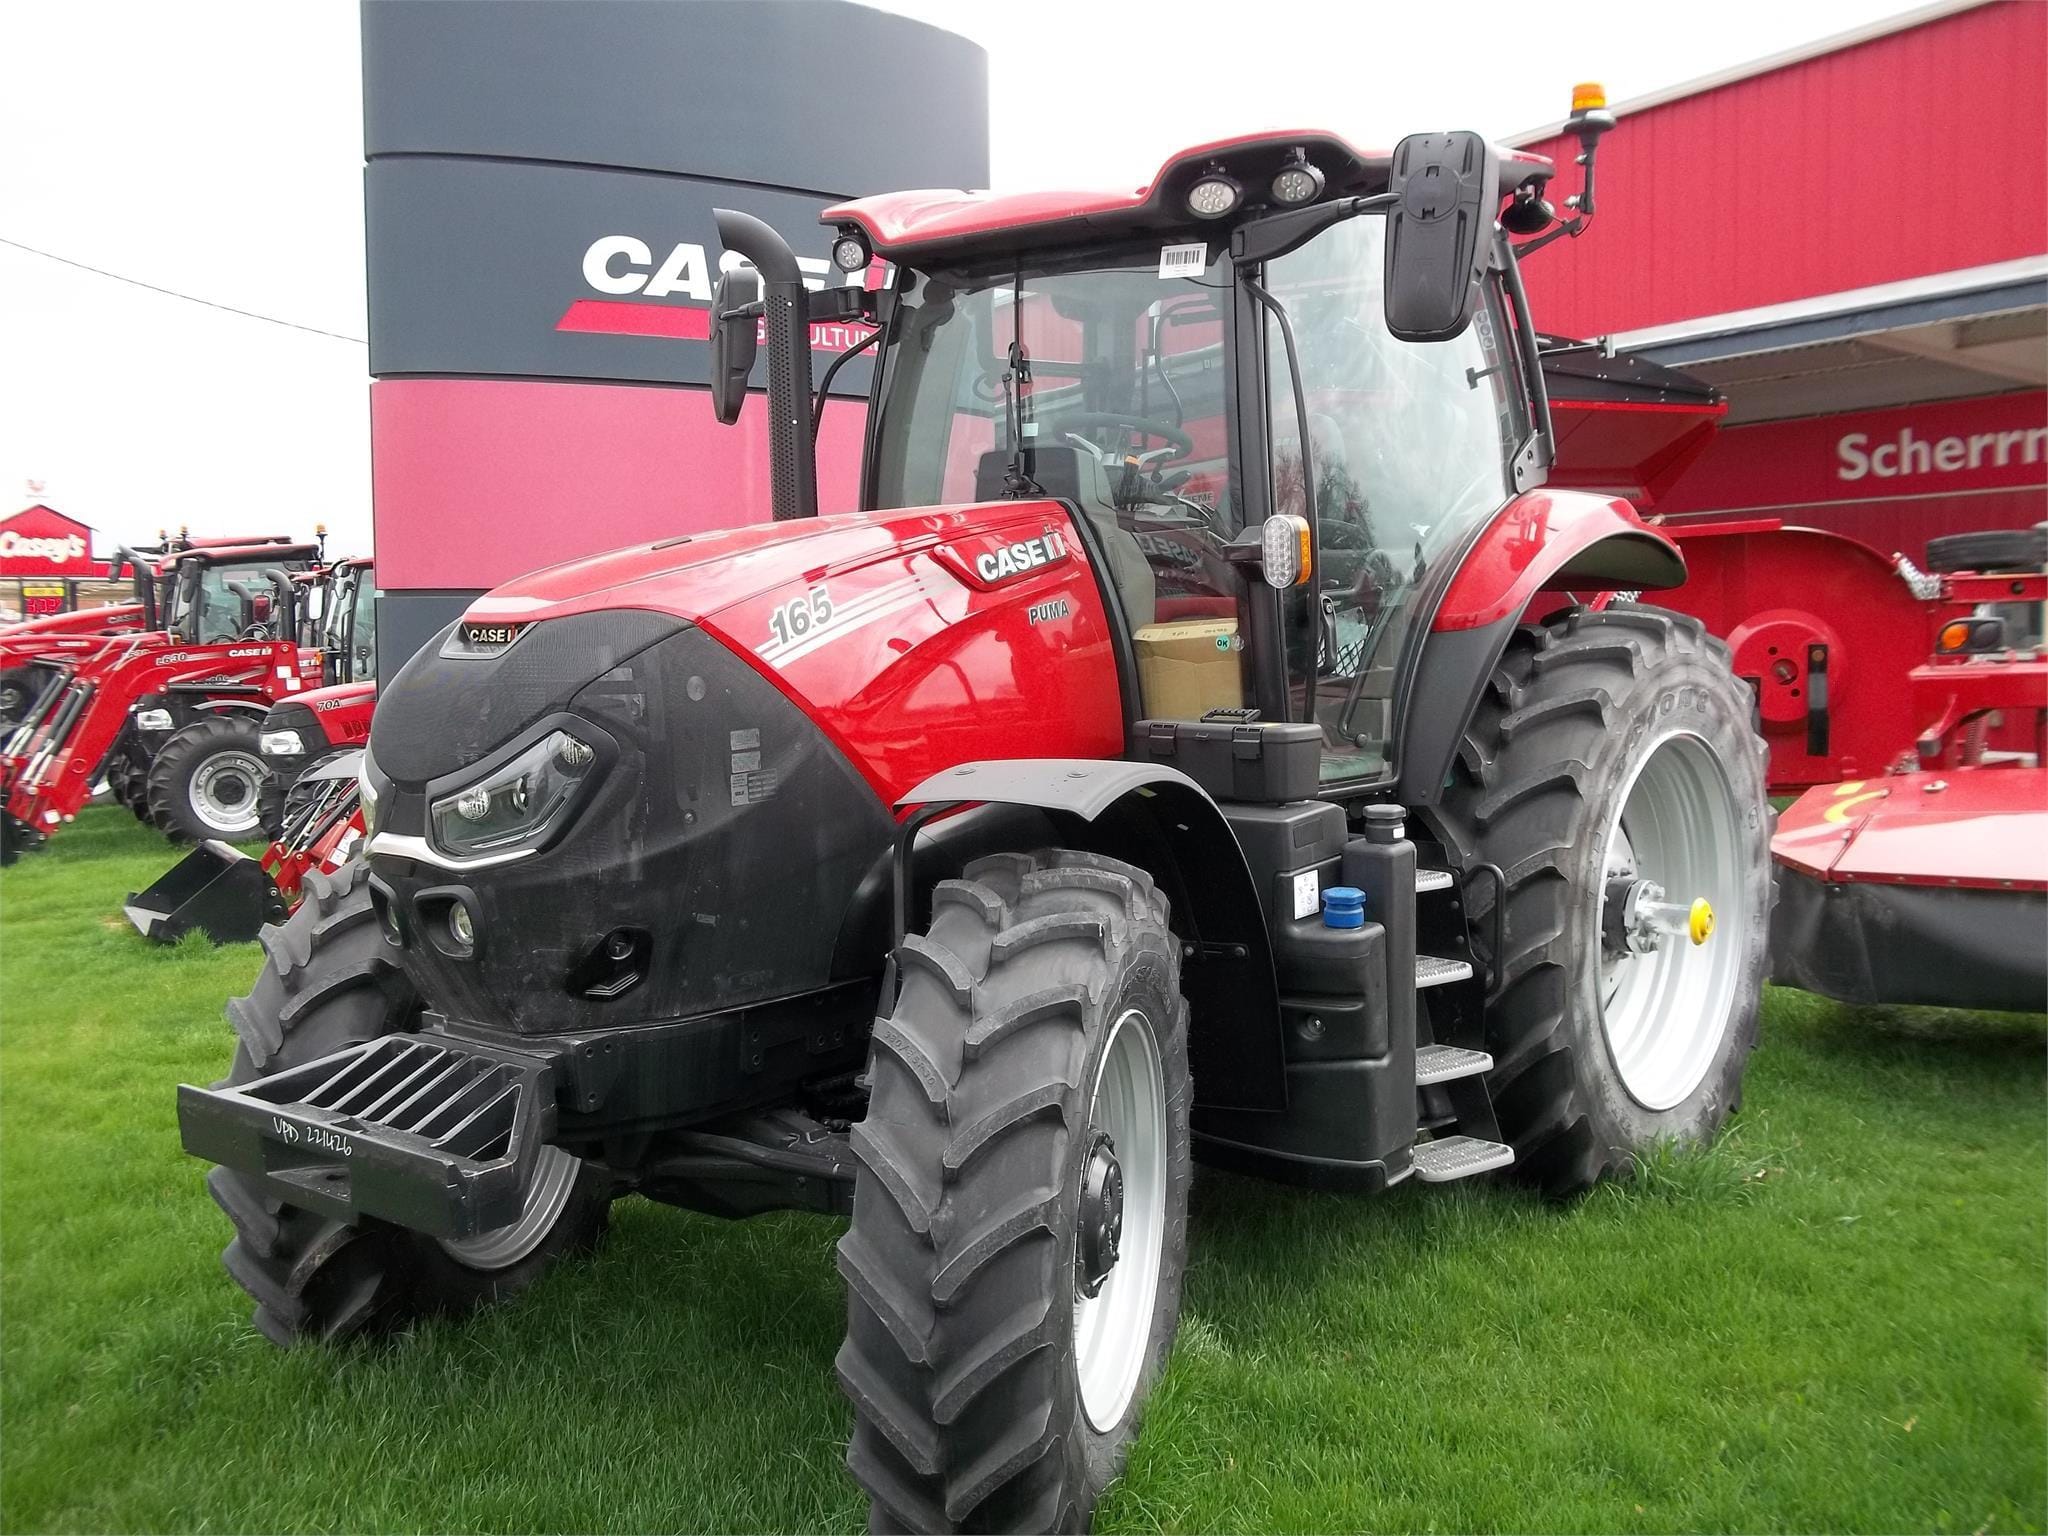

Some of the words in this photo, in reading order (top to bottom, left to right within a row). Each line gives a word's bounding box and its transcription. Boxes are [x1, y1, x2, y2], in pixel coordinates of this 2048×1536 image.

[0, 530, 87, 563] Casey's
[976, 538, 1047, 582] CASE
[769, 584, 833, 645] 165
[1029, 599, 1069, 625] PUMA
[470, 628, 506, 643] CASE
[1216, 638, 1228, 649] OK
[155, 652, 188, 666] L630
[229, 649, 261, 657] CASE
[316, 698, 341, 712] 70A
[273, 1116, 299, 1144] VPD
[306, 1126, 352, 1156] 221426
